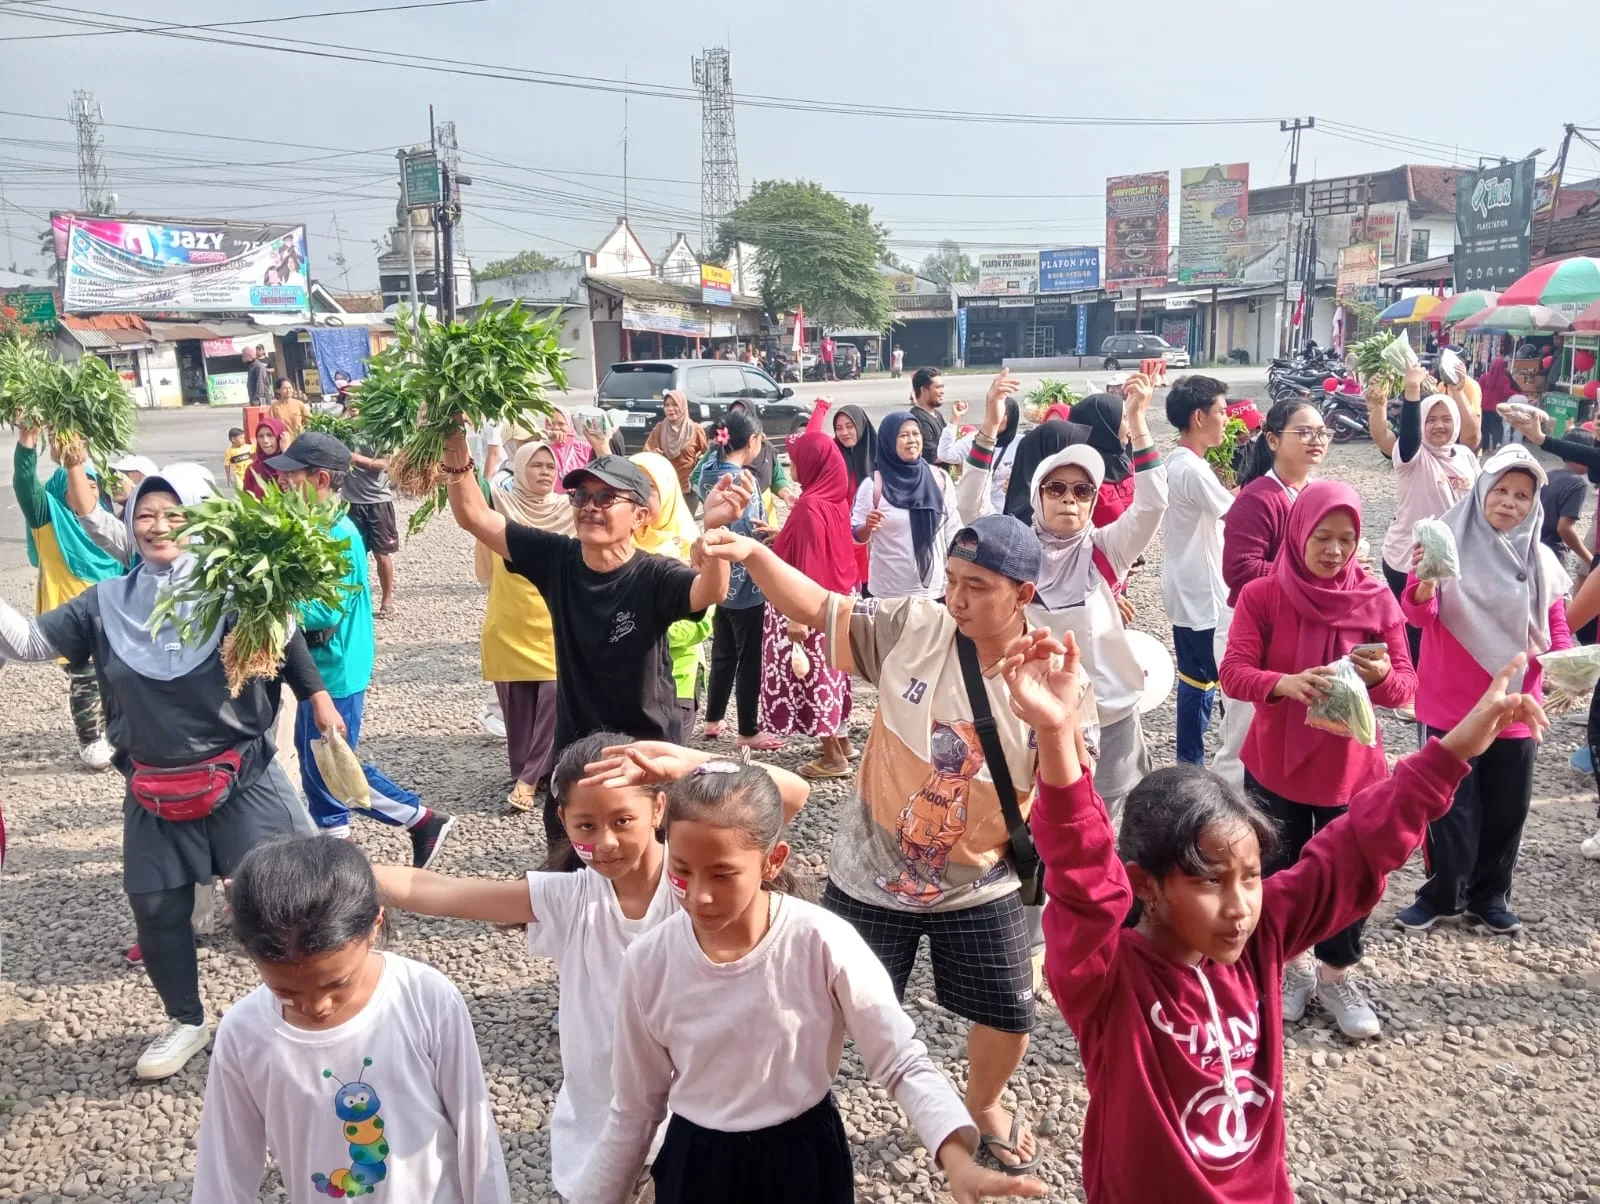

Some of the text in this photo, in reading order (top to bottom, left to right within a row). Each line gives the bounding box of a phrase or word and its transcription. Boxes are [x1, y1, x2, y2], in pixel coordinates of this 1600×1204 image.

[982, 259, 1002, 268] PLAFON
[1002, 259, 1012, 268] PVC
[1041, 257, 1097, 270] PLAFON PVC
[902, 677, 928, 705] 19
